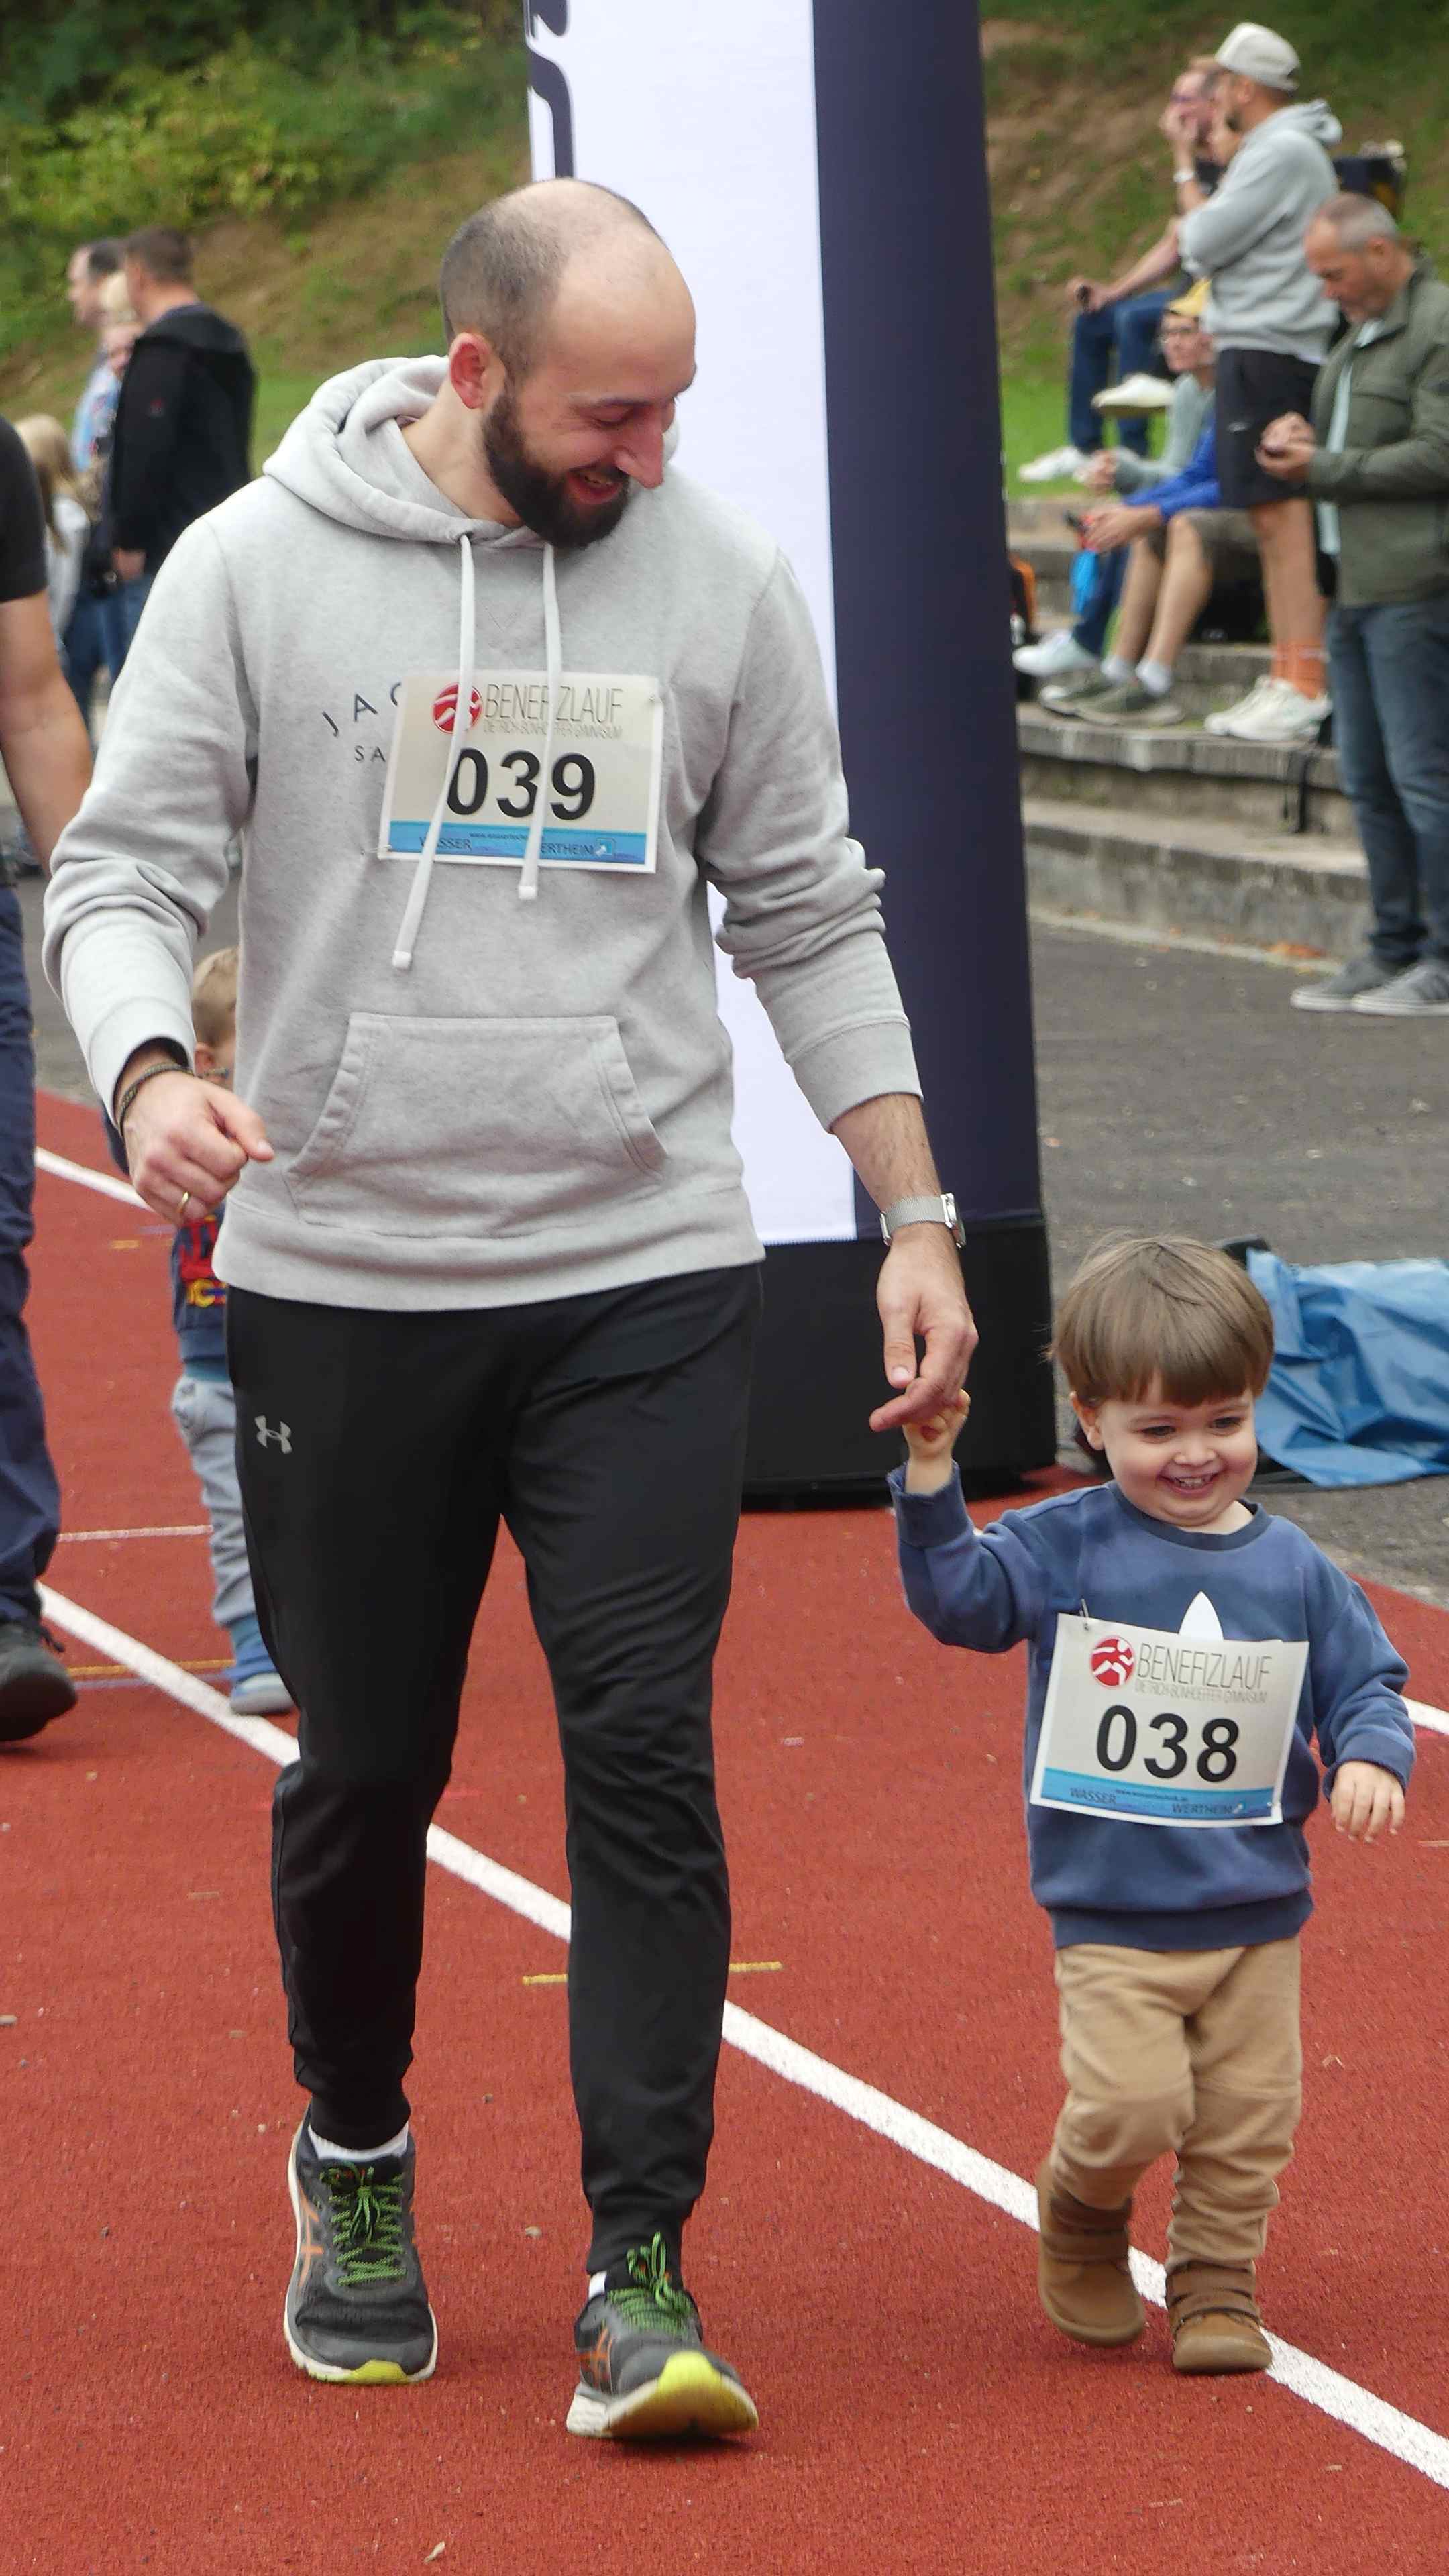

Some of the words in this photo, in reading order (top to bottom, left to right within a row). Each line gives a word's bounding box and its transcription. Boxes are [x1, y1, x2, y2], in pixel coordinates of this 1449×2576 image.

[484, 683, 624, 724] BENEFZLAUF
[447, 747, 596, 821] 039
[1137, 1642, 1273, 1690] BENEFIZLAUF
[1096, 1704, 1240, 1783] 038
[1070, 1786, 1117, 1805] WASSER
